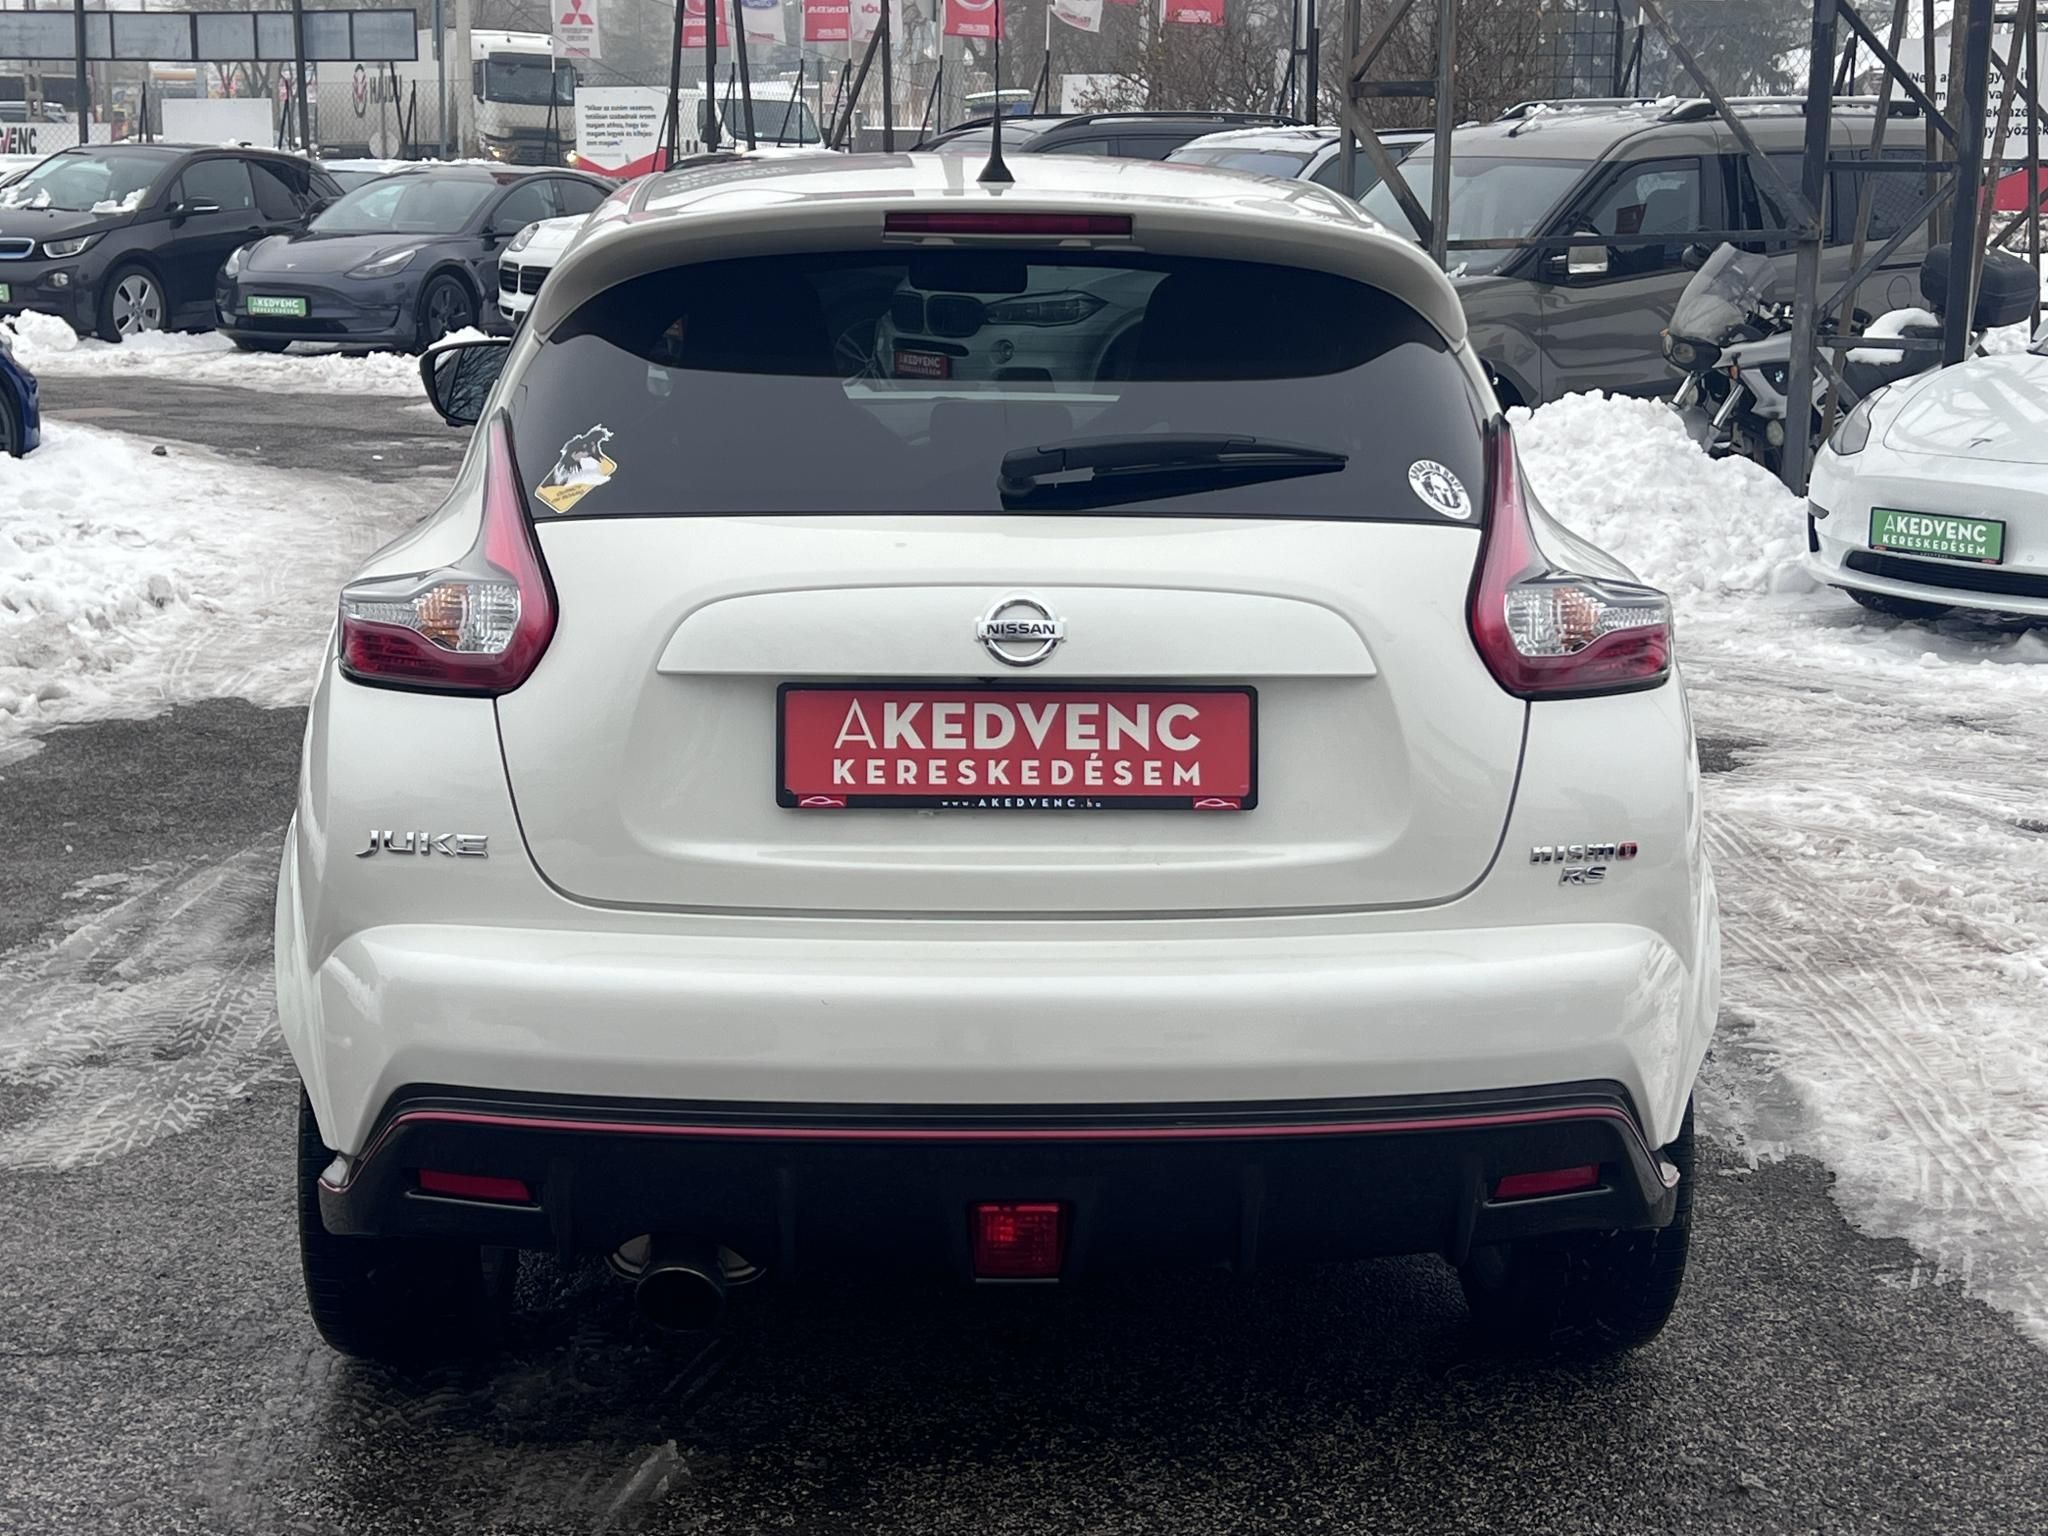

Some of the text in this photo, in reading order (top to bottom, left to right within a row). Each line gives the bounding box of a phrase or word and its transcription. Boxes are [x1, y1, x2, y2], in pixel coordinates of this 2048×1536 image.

[1884, 514, 1988, 543] AKEDVENC
[1882, 533, 1986, 556] KERESKEDÉSEM
[986, 623, 1056, 635] NISSAN
[833, 697, 1202, 752] AKEDVENC
[832, 754, 1201, 787] KERESKEDÉSEM
[354, 830, 489, 858] JUKE
[1558, 865, 1607, 886] RS
